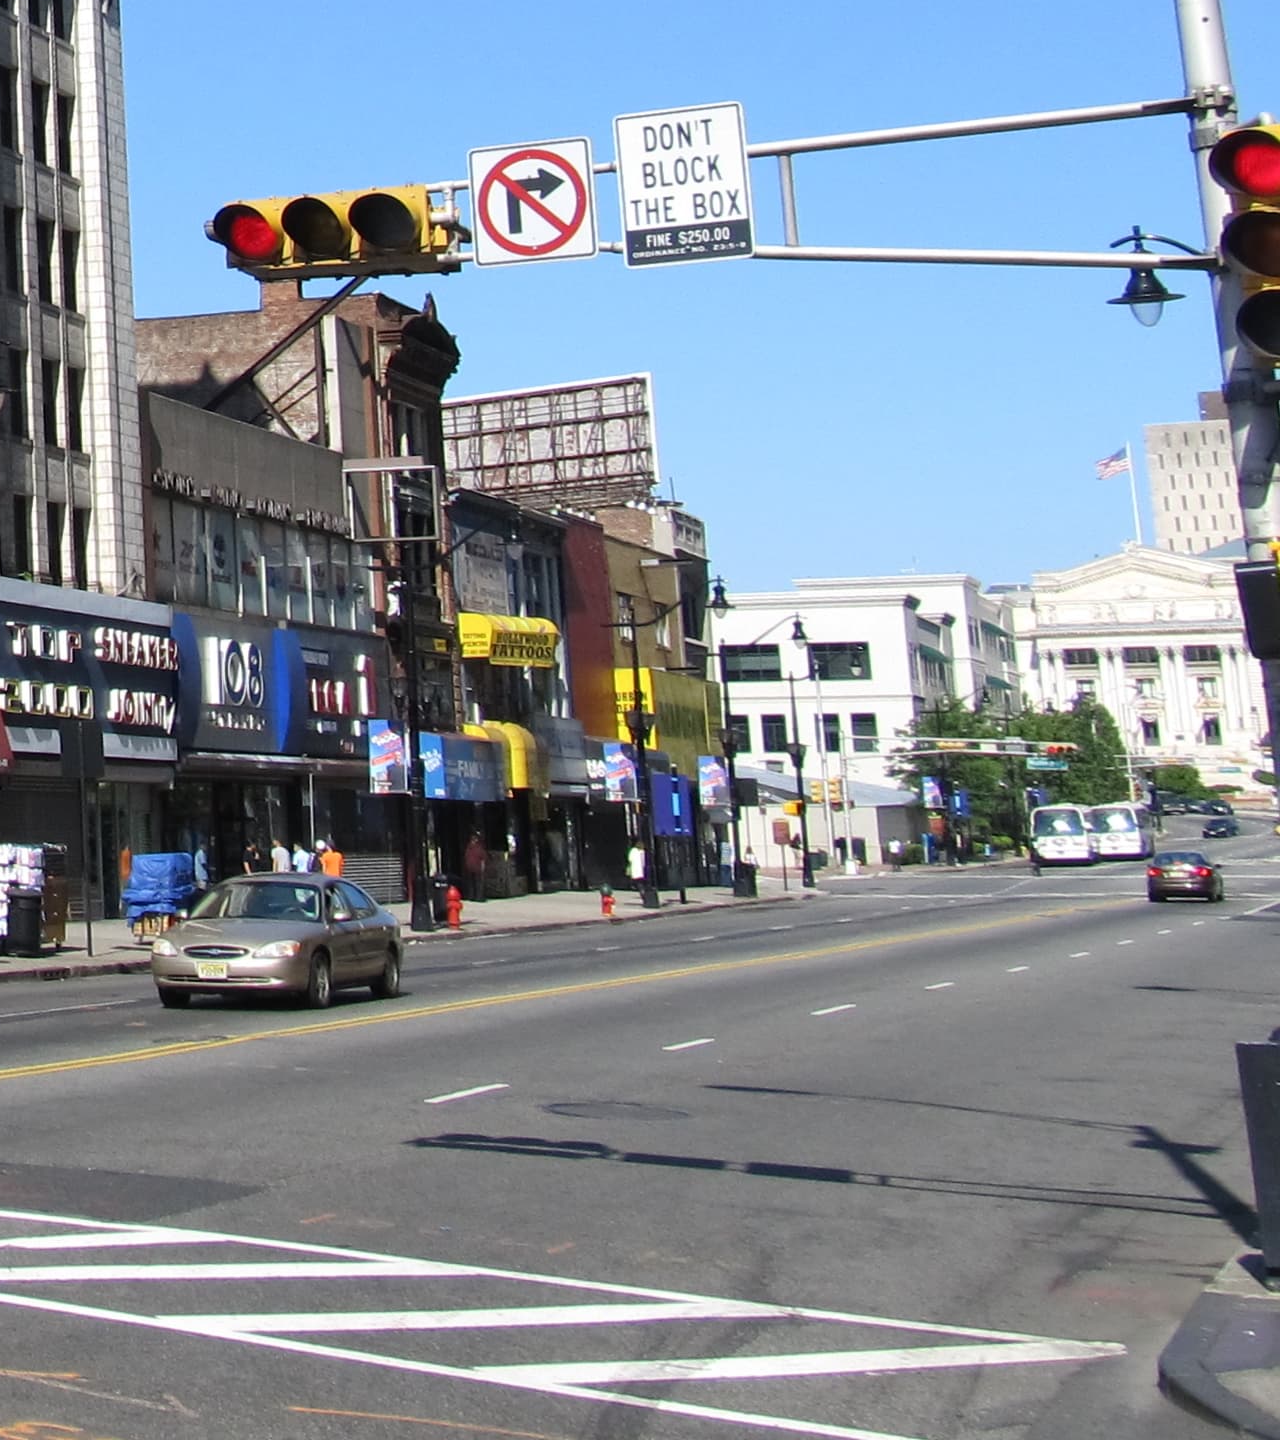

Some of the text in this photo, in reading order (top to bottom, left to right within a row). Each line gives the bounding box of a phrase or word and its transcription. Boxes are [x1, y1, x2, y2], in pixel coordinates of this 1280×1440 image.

[642, 118, 713, 153] DON'T
[642, 155, 723, 189] BLOCK
[630, 189, 741, 226] THE BOX
[645, 226, 731, 248] FINE $250.00
[5, 621, 83, 663] TOP
[492, 644, 553, 659] TATTOOS
[203, 636, 264, 709] 108
